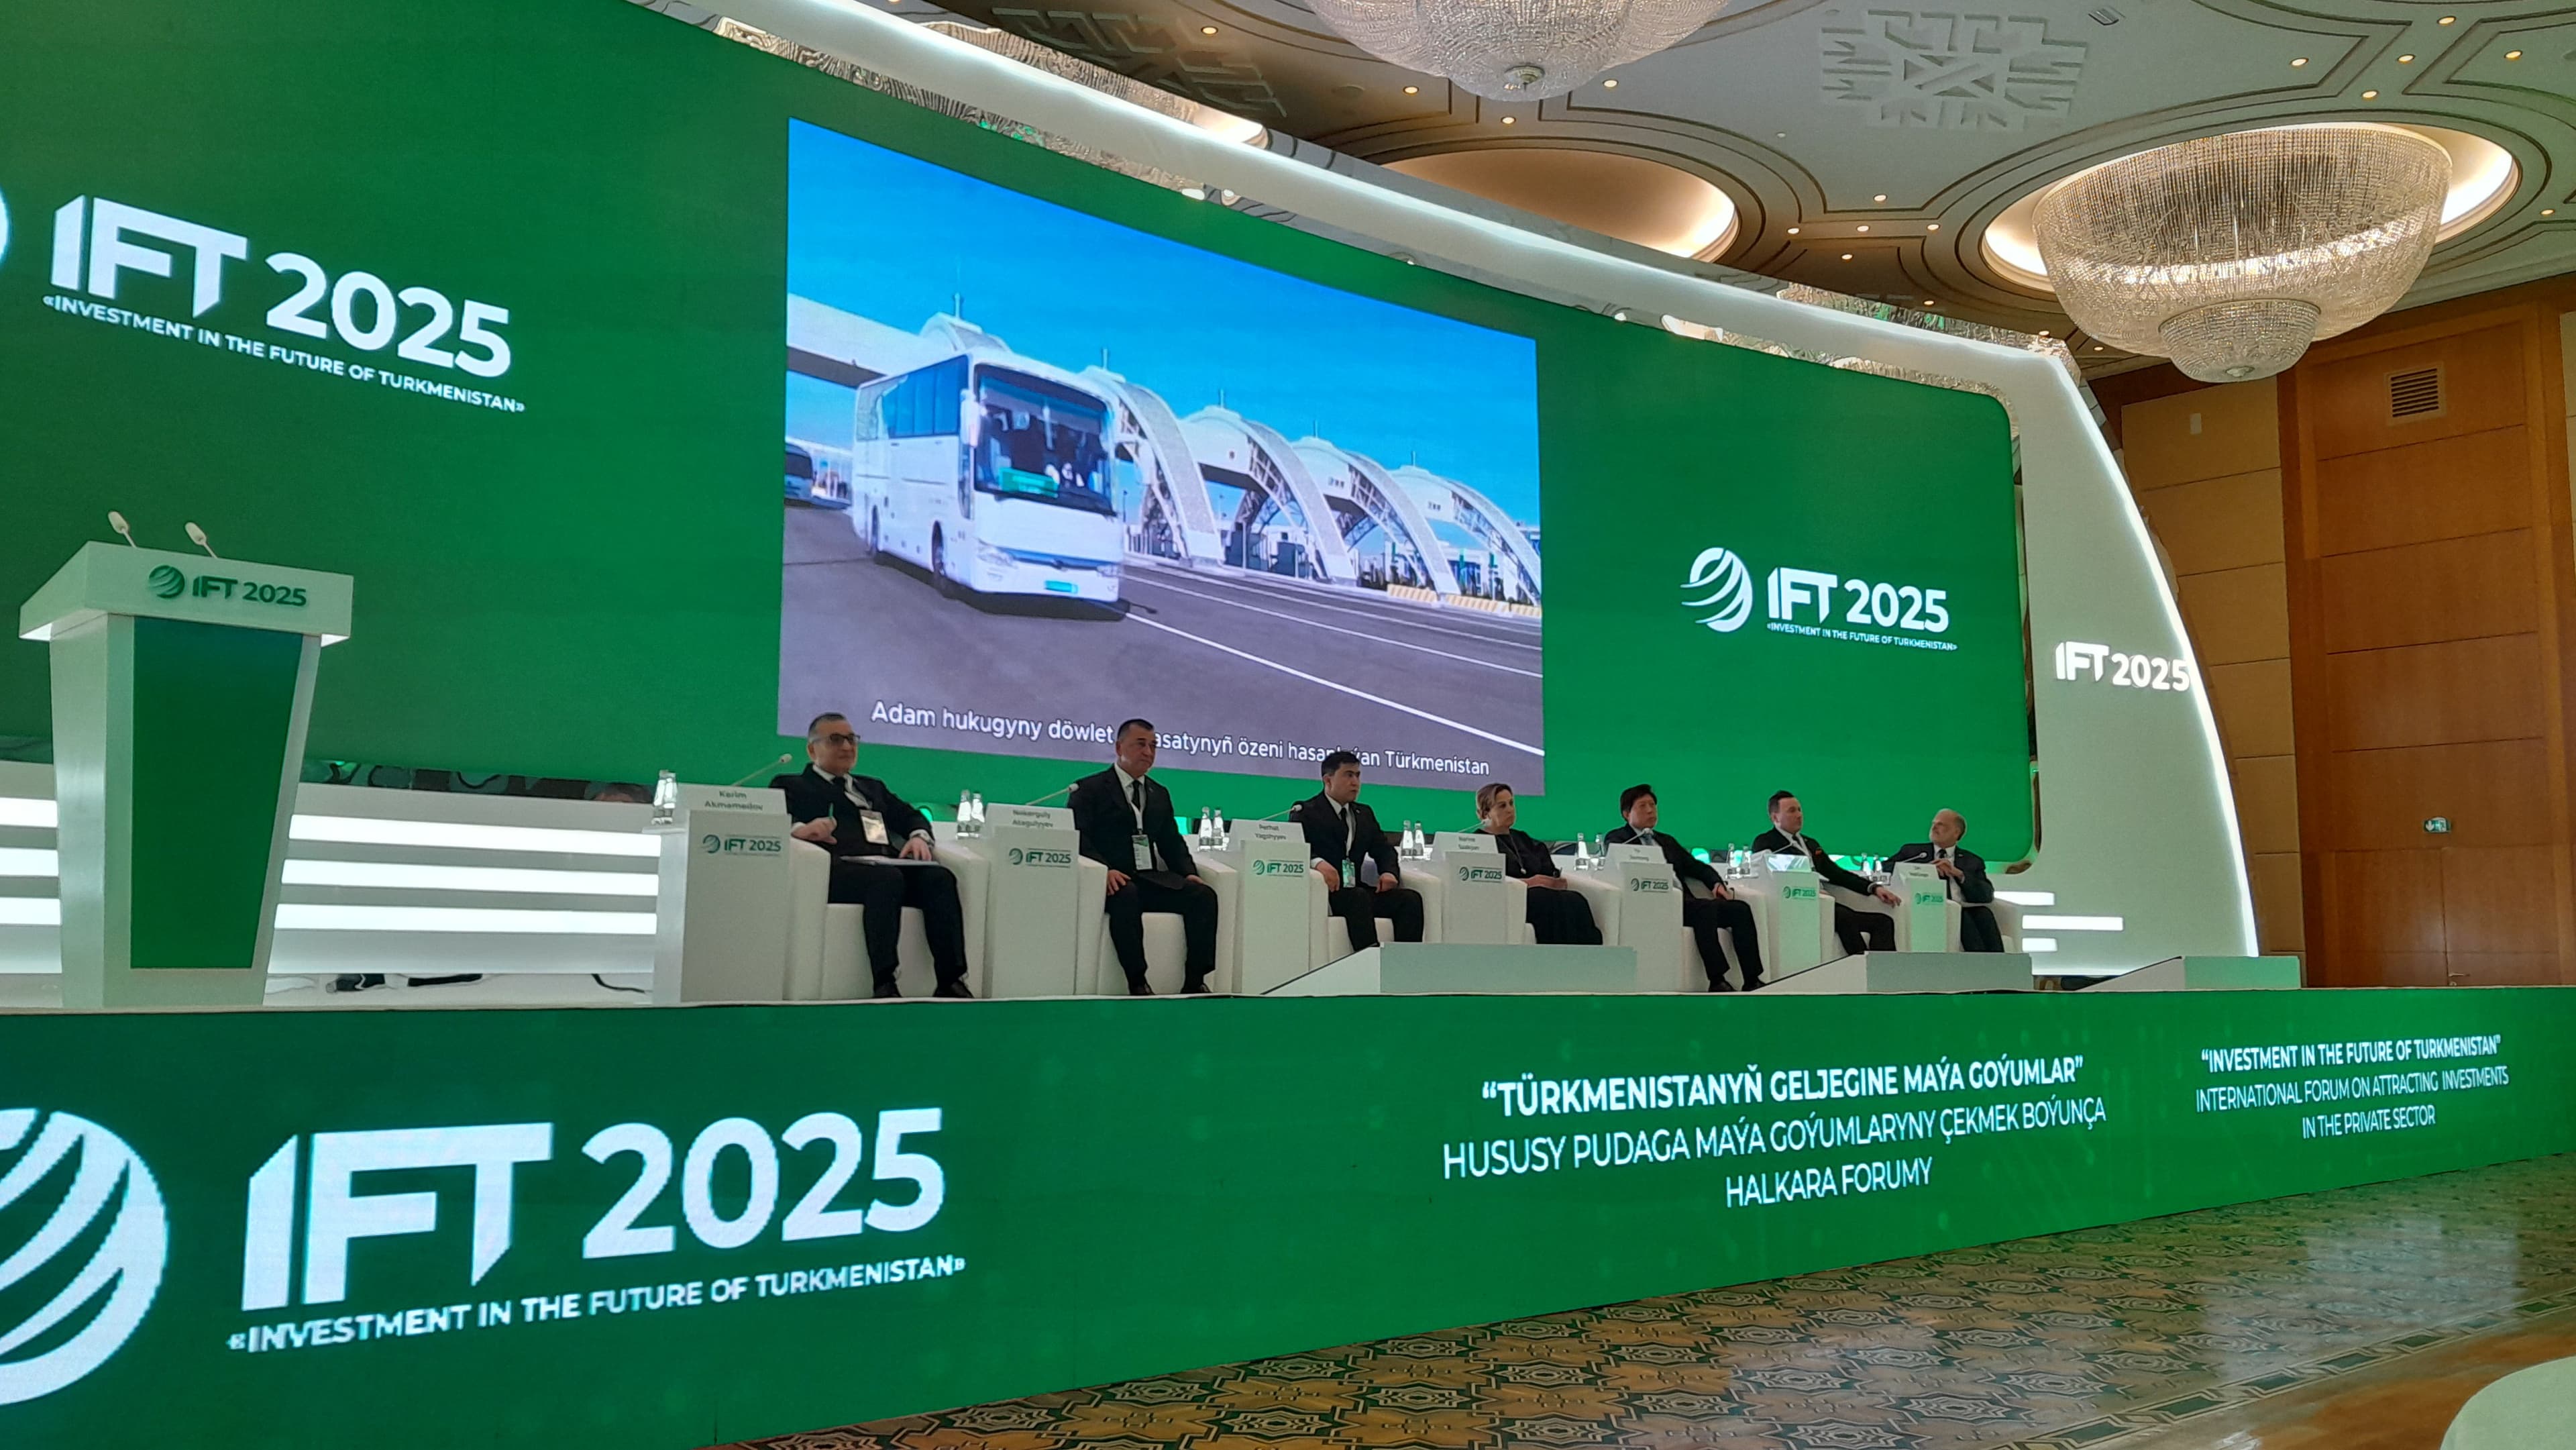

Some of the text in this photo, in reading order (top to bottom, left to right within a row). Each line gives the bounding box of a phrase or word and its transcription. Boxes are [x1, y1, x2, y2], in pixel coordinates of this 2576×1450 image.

[51, 194, 511, 378] IFT 2025
[43, 295, 525, 413] «INVESTMENT IN THE FUTURE OF TURKMENISTAN»
[193, 575, 307, 607] IFT 2025
[1767, 566, 1949, 633] IFT 2025
[1822, 628, 1831, 637] IN
[1832, 629, 1847, 640] THE
[1849, 631, 1880, 643] FUTURE
[1881, 635, 1892, 644] OF
[2055, 641, 2190, 692] IFT 2025
[871, 701, 1490, 776] Adam hukugyny döwlet asatynyñ özeni hasaan Türkmenistan
[724, 838, 782, 852] IFT 2025
[1026, 851, 1071, 864] IFT 2025
[1267, 862, 1304, 874] IFT 2025
[1470, 869, 1502, 880] IFT 2025
[1770, 1064, 1899, 1102] GELJEGINE
[1903, 1055, 1966, 1094] MAÝA
[1968, 1053, 2084, 1090] GOÝUMLAR”
[2201, 1033, 2502, 1073] “INVESTMENT IN THE FUTURE OF TURKMENISTAN”
[2195, 1065, 2510, 1112] INTERNATIONAL FORUM ON ATTRACTING INVESTMENTS
[1443, 1093, 2106, 1180] HUSUSY PUDAGA MAÝA GOÝUMLARYNY ÇEKMEK BOÝUNÇA
[2301, 1104, 2436, 1139] IN THE PRIVATE SECTOR
[1725, 1156, 1933, 1208] HALKARA FORUMY
[241, 1107, 945, 1311] IFT 2025
[478, 1300, 512, 1327] IN
[520, 1292, 582, 1323] THE
[588, 1280, 704, 1316] FUTURE
[710, 1276, 749, 1303] OF
